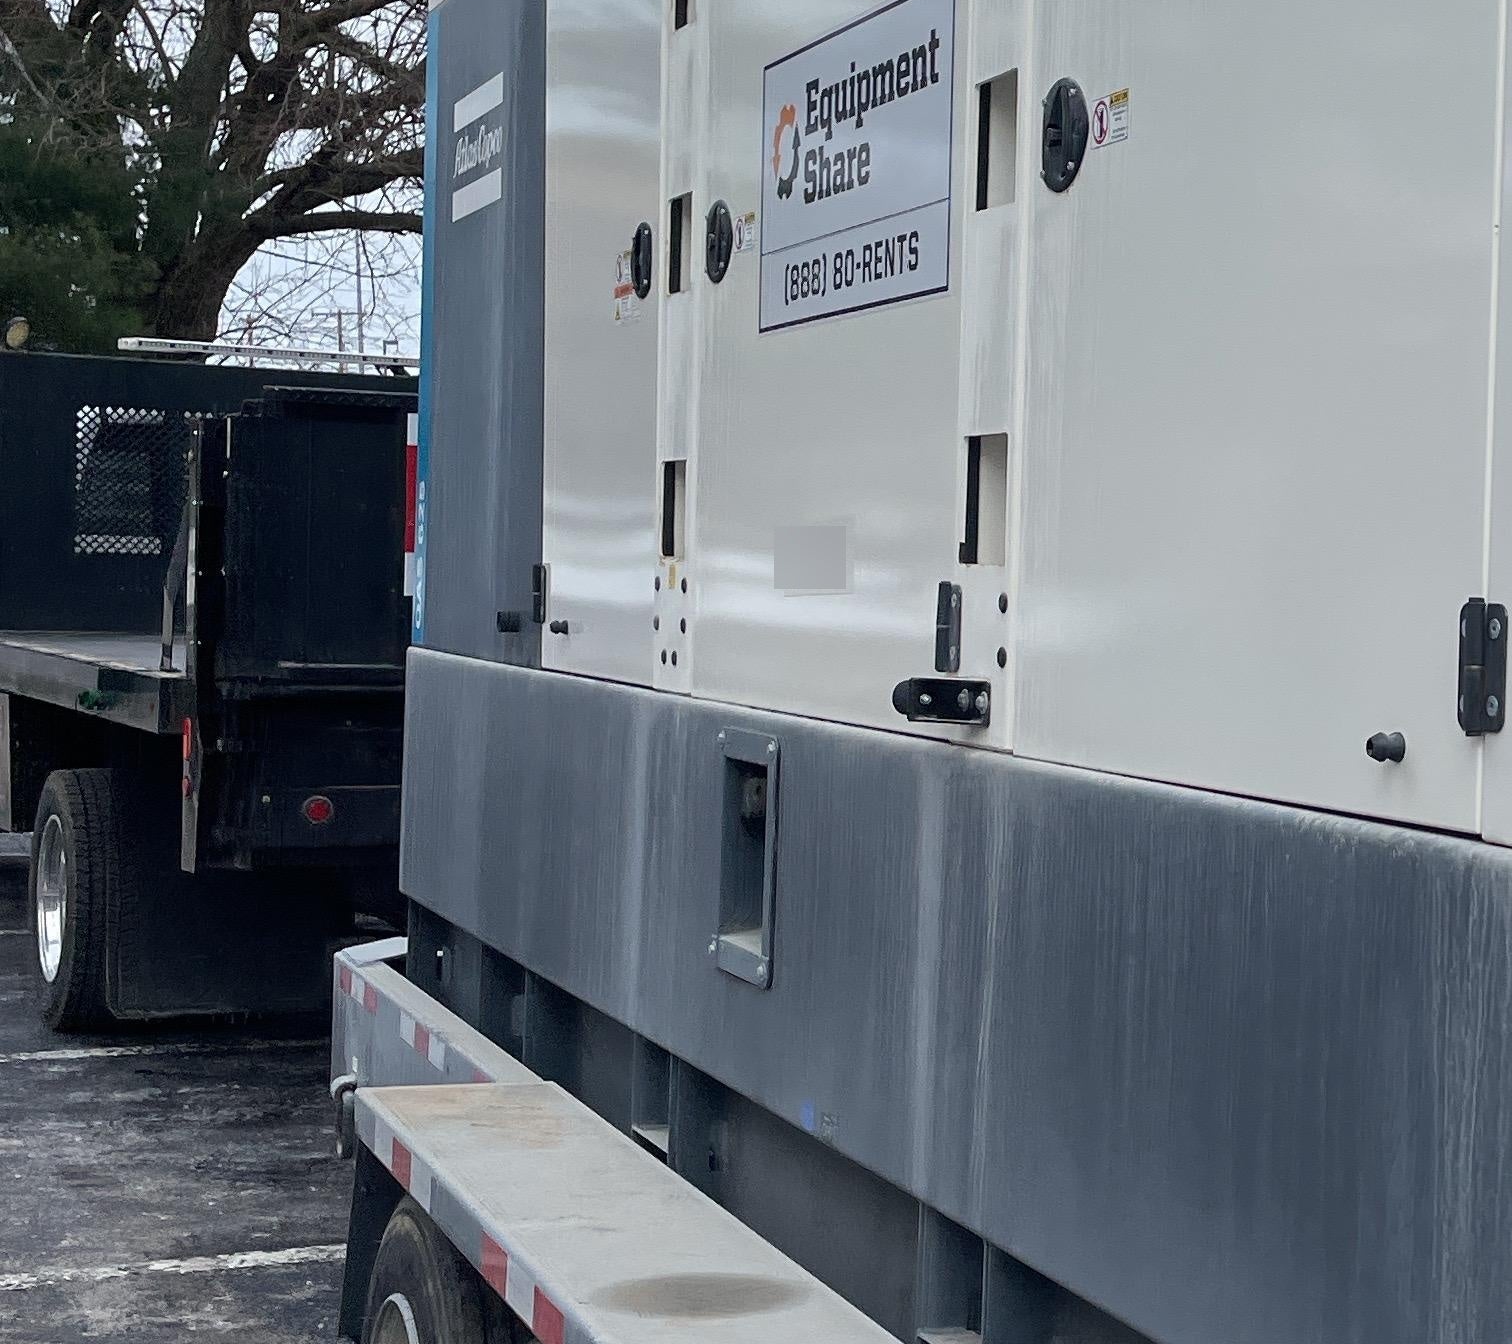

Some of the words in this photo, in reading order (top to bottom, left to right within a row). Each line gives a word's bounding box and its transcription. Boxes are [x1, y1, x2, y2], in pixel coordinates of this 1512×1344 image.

[804, 29, 940, 141] Equipment
[803, 141, 870, 205] Share
[784, 253, 827, 305] (888)
[833, 230, 919, 291] 80-RENTS
